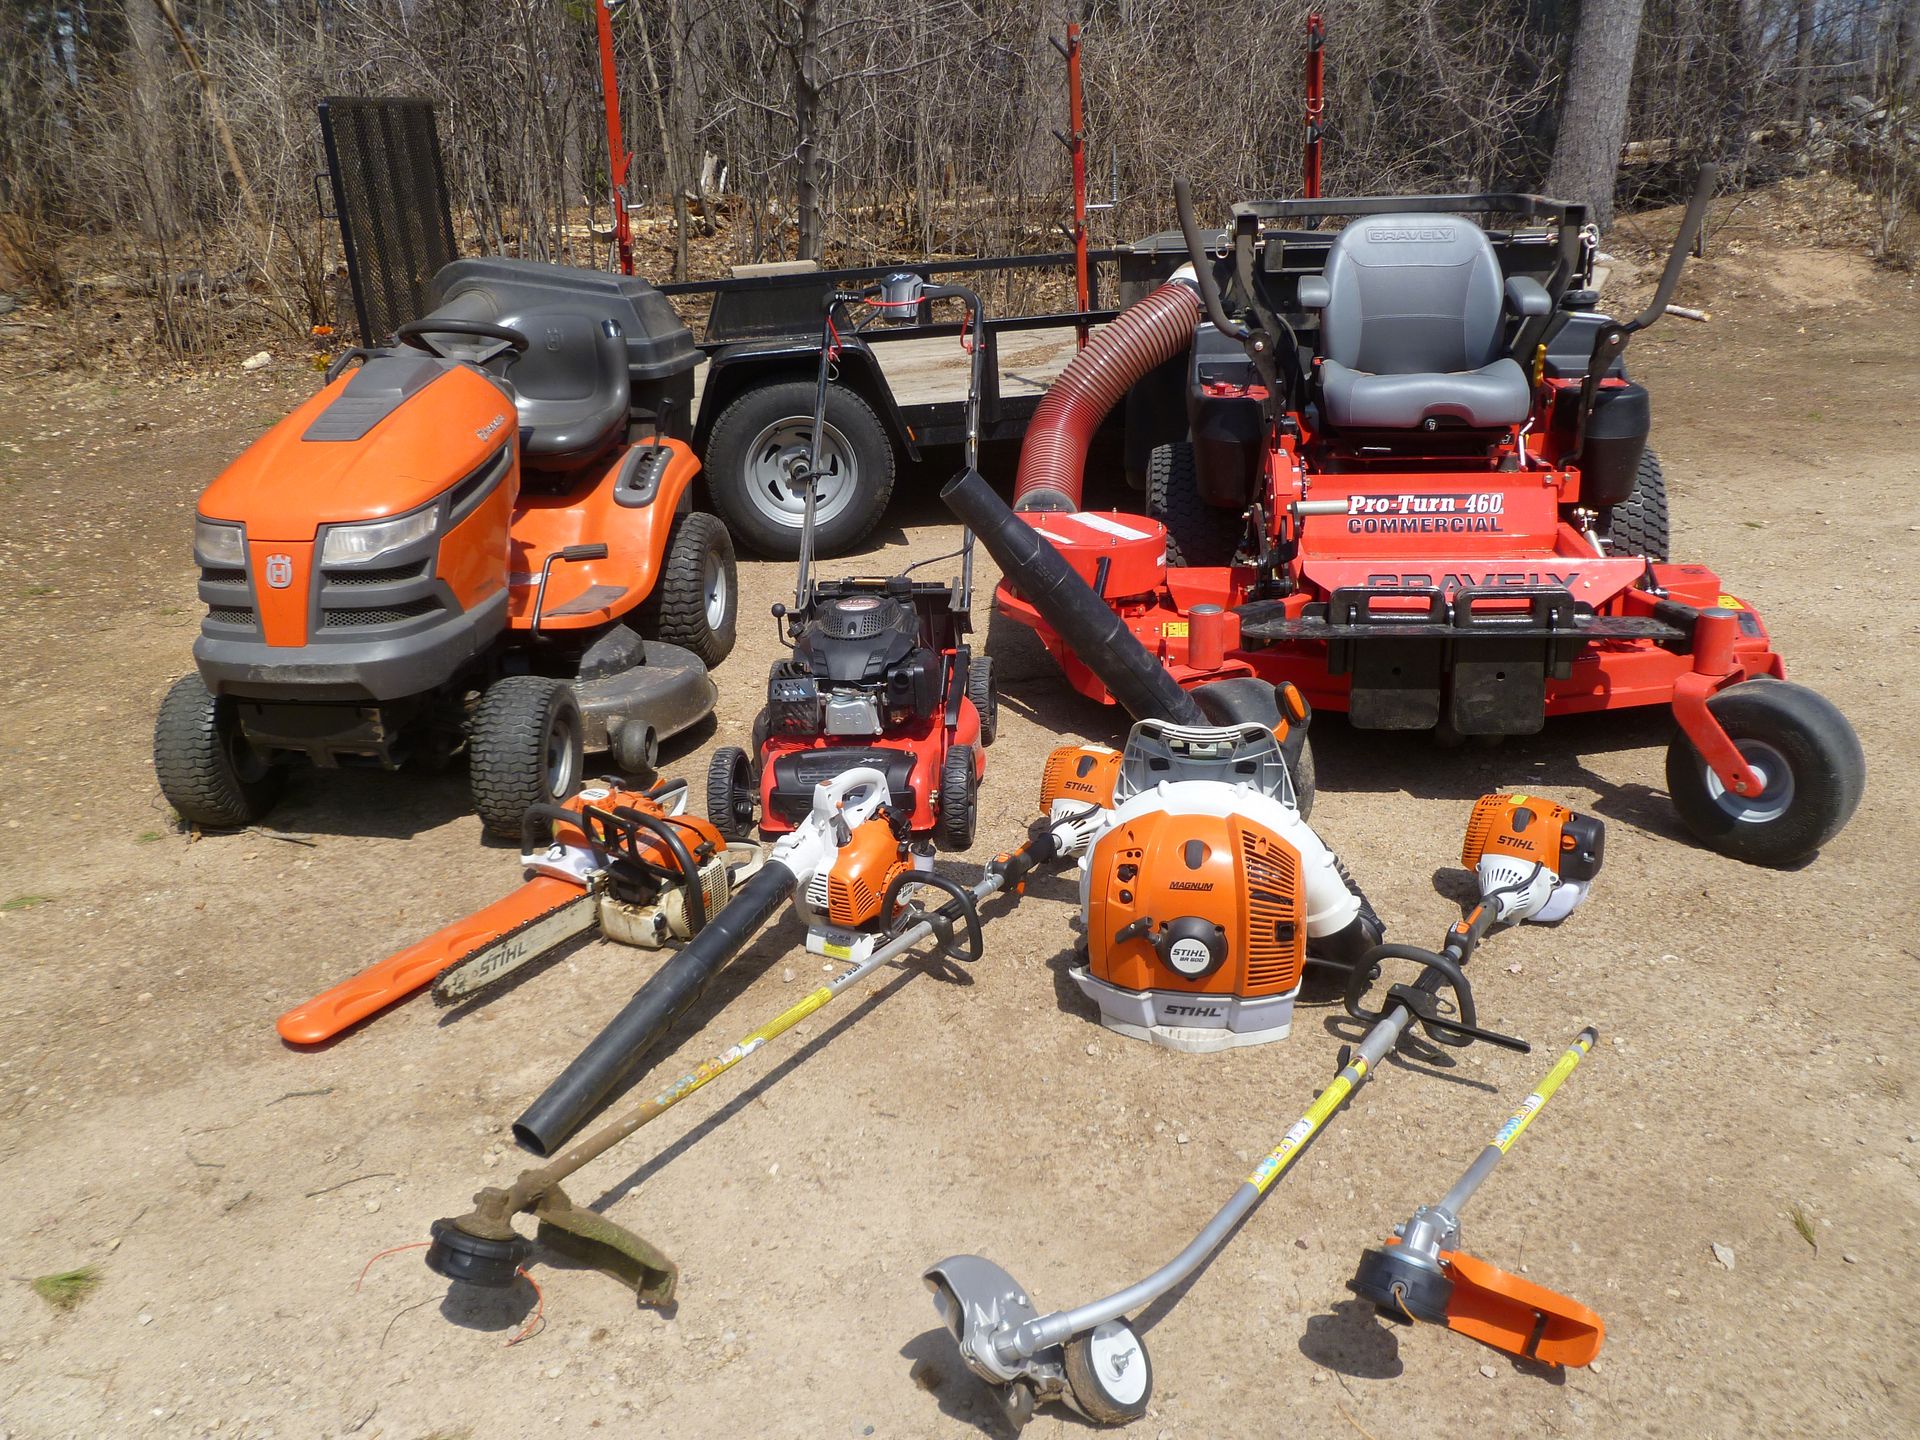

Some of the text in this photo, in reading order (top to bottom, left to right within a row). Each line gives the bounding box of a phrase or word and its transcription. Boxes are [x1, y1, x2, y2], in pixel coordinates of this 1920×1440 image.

[1370, 229, 1453, 241] GRAVELY
[1348, 494, 1503, 514] Pro-Turn 460
[1348, 517, 1504, 534] COMMERCIAL
[1064, 781, 1095, 793] STIHL
[1497, 835, 1535, 851] STIHL
[1169, 881, 1214, 892] MAGNUM
[1172, 948, 1206, 957] STIHL
[479, 942, 528, 977] STIHL
[1163, 1004, 1222, 1017] STIHL
